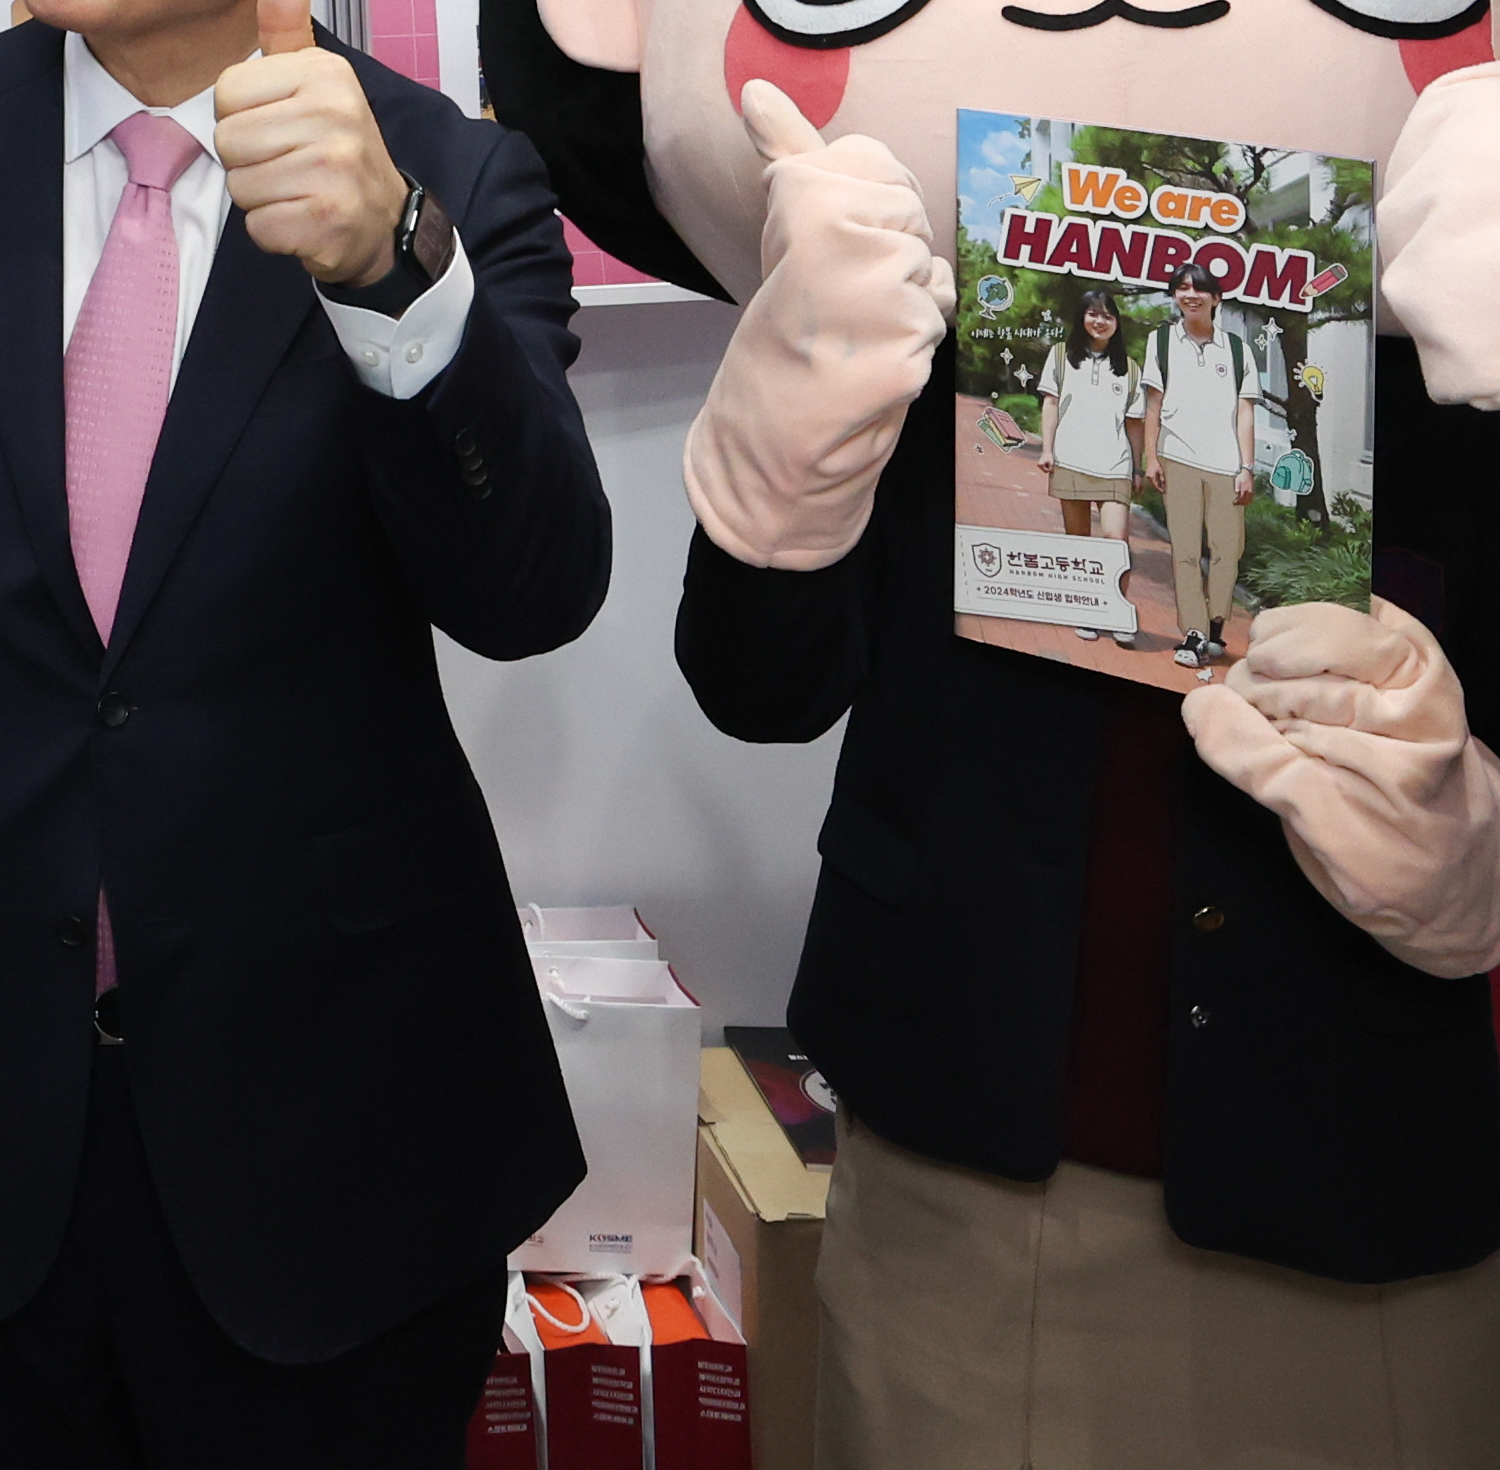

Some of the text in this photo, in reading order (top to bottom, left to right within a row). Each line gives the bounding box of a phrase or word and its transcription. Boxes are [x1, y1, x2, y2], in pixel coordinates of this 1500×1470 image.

[1066, 167, 1241, 228] We are
[1003, 213, 1314, 307] HANBOM
[1006, 550, 1106, 577] 한봄고등학교
[1009, 569, 1106, 585] HANBOM HIGH SCHOOL
[984, 585, 1100, 608] 2024학년도 신입생 입학안내
